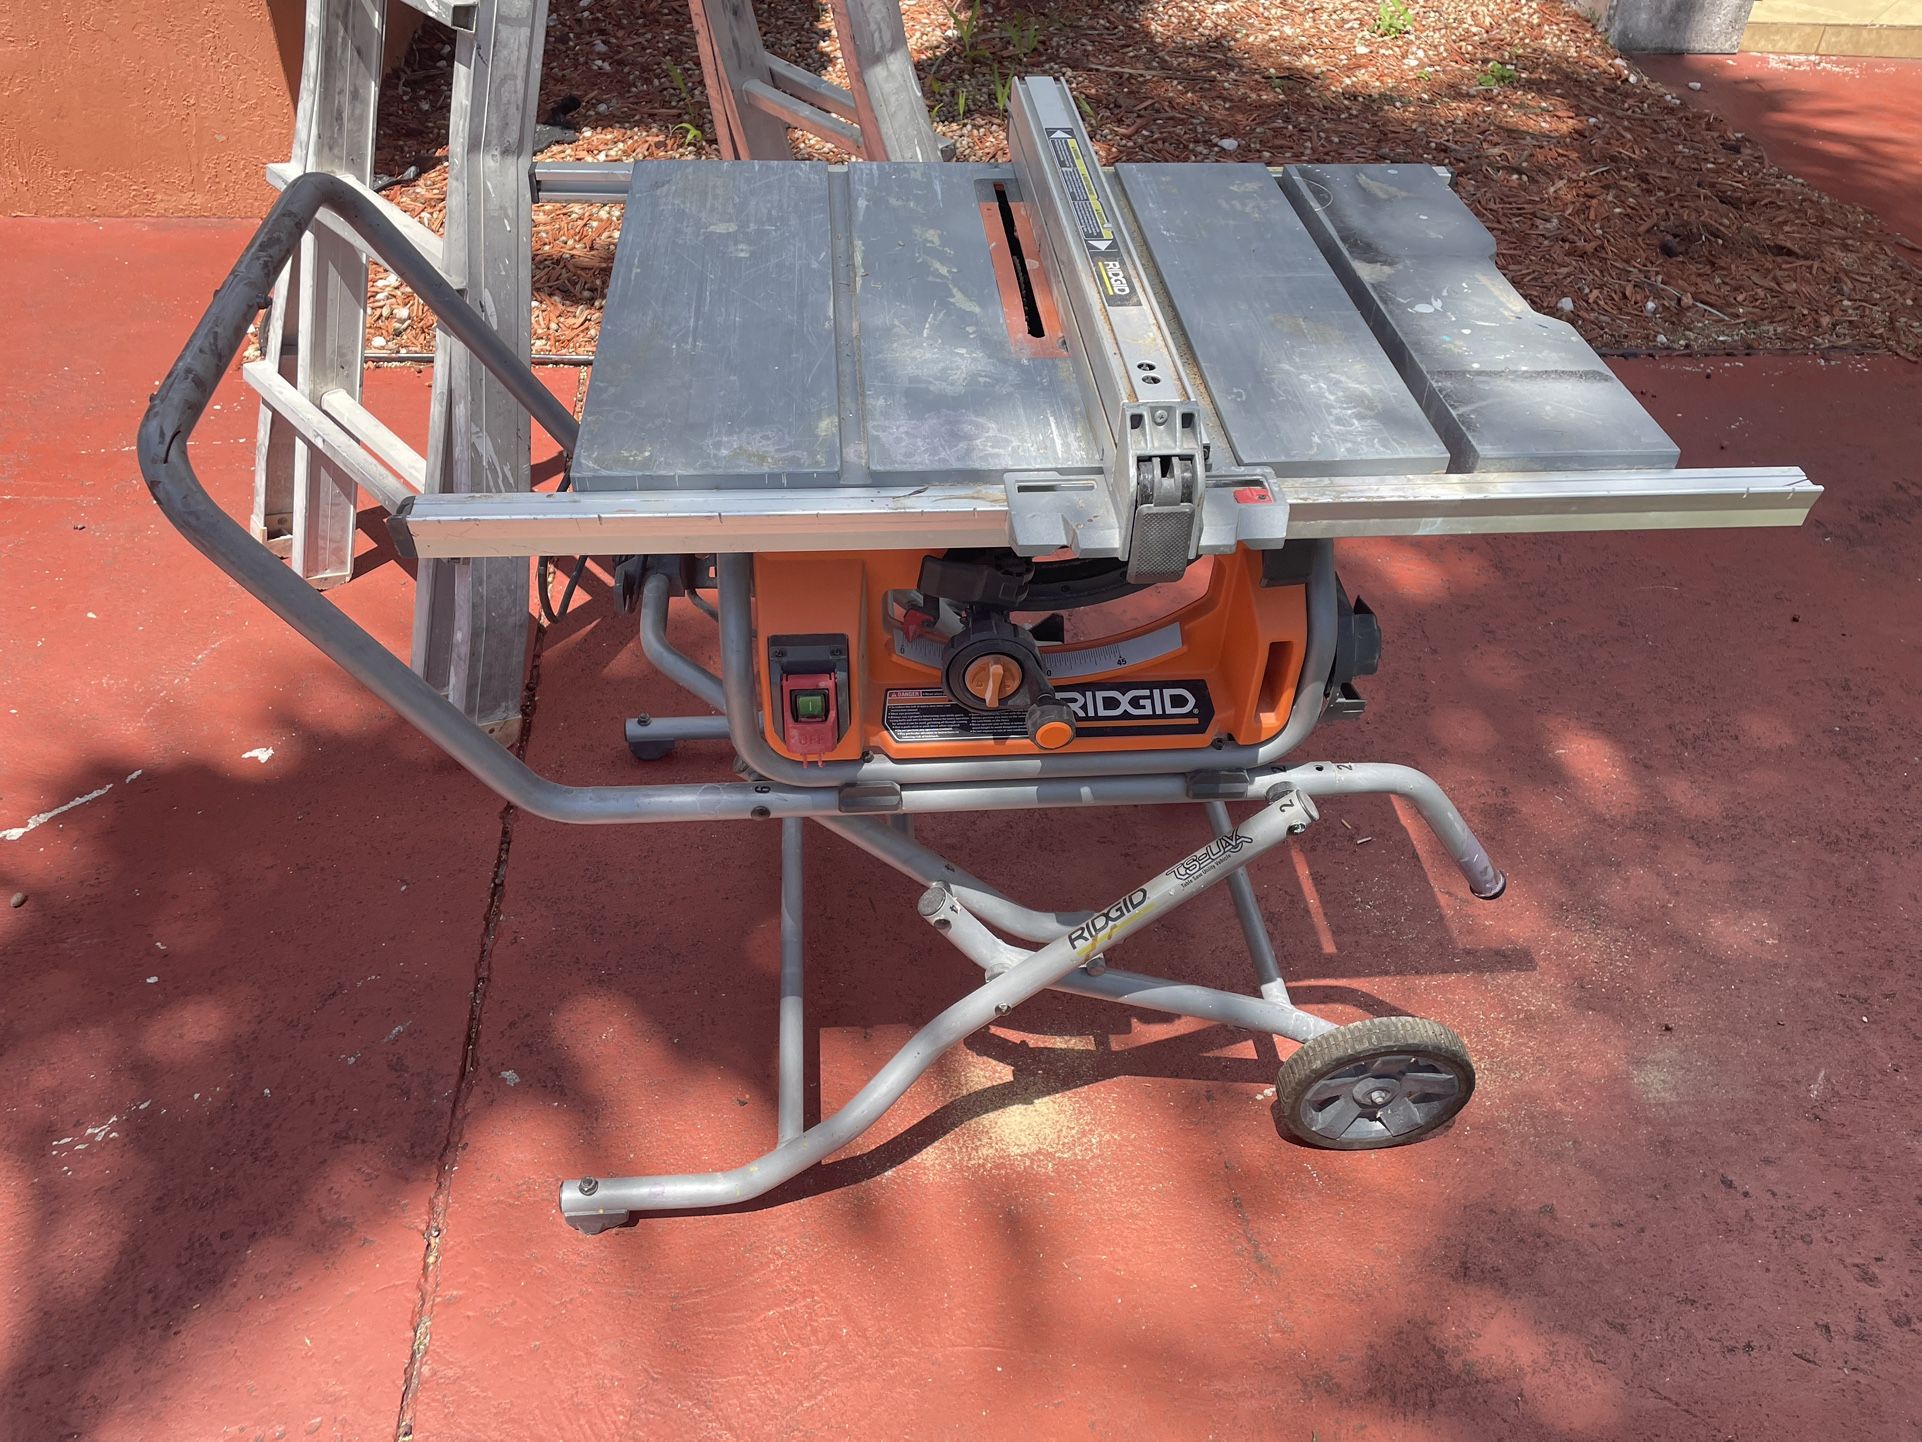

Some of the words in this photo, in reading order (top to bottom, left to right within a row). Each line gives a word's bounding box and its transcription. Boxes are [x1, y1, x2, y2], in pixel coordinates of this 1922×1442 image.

[1104, 261, 1130, 295] RIDGID
[1117, 657, 1127, 666] 45
[1055, 688, 1196, 717] RIDGID
[1280, 799, 1295, 813] 2
[1214, 853, 1232, 866] Vehicle
[1068, 887, 1148, 951] RIDGID
